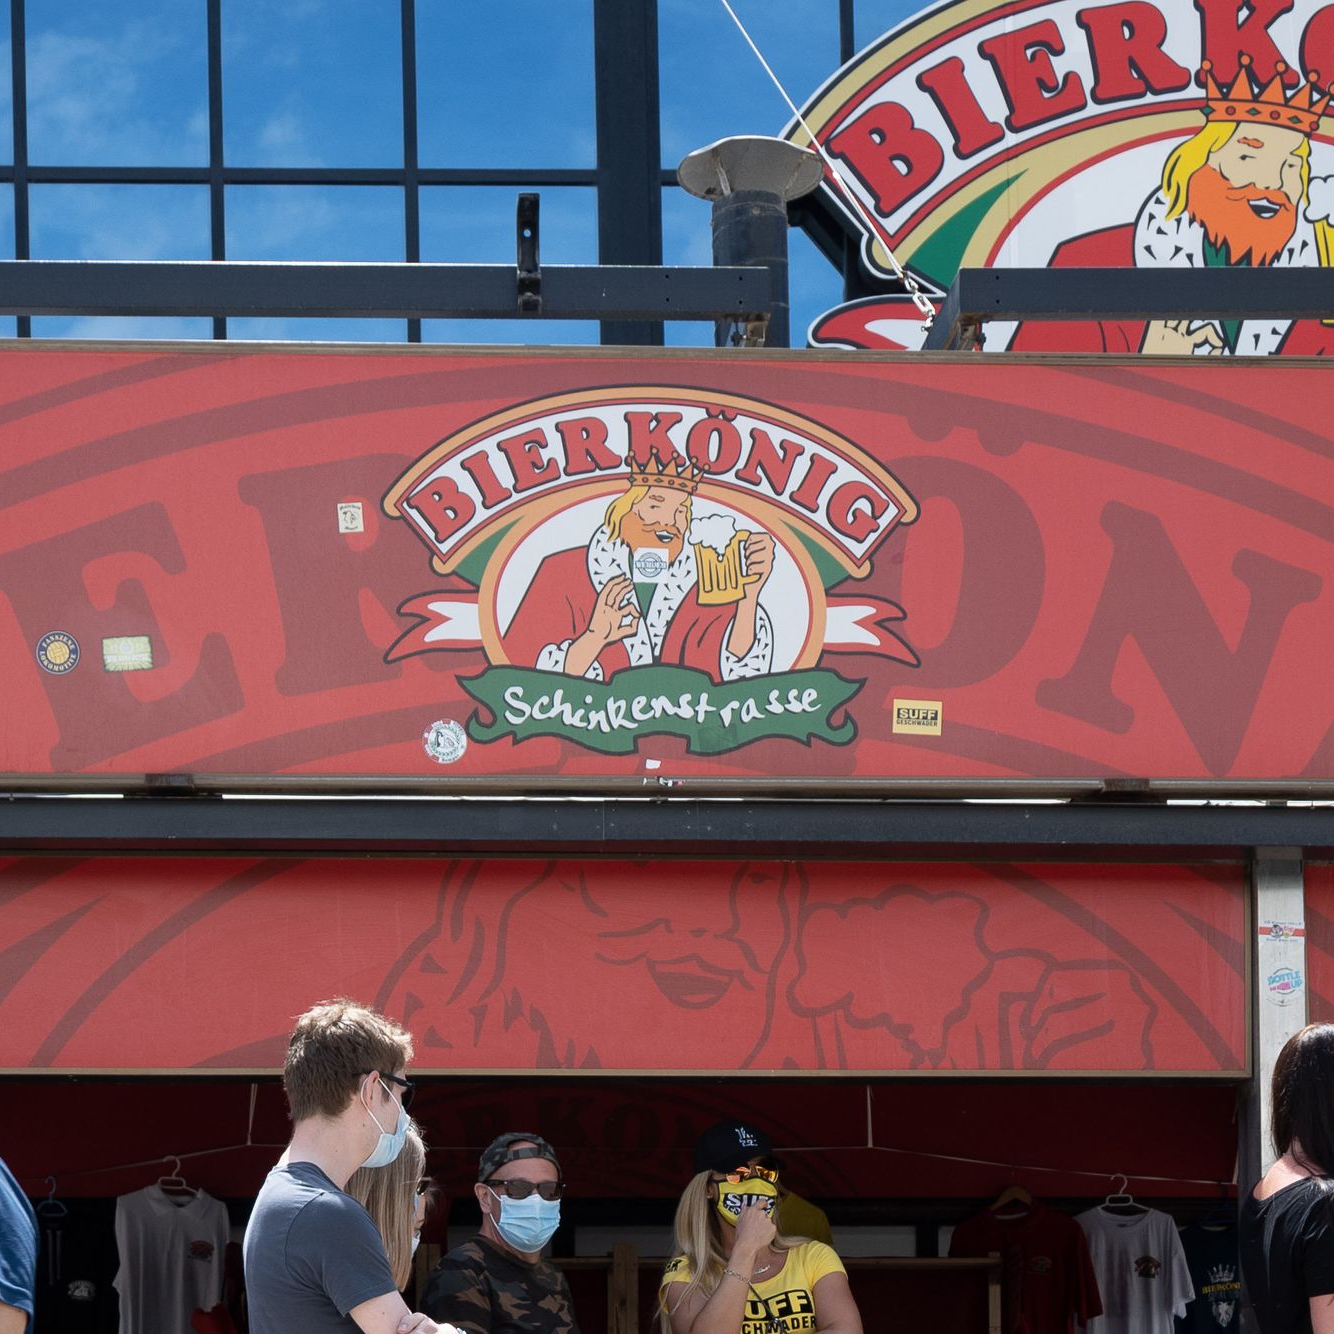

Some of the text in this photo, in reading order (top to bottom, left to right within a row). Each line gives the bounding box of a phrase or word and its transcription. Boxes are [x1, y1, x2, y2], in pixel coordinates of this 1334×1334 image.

[408, 407, 890, 543] BIERKÖNIG
[503, 686, 822, 734] Schinkenstrasse
[896, 719, 938, 727] GESCHWADER
[899, 708, 936, 720] SUFF
